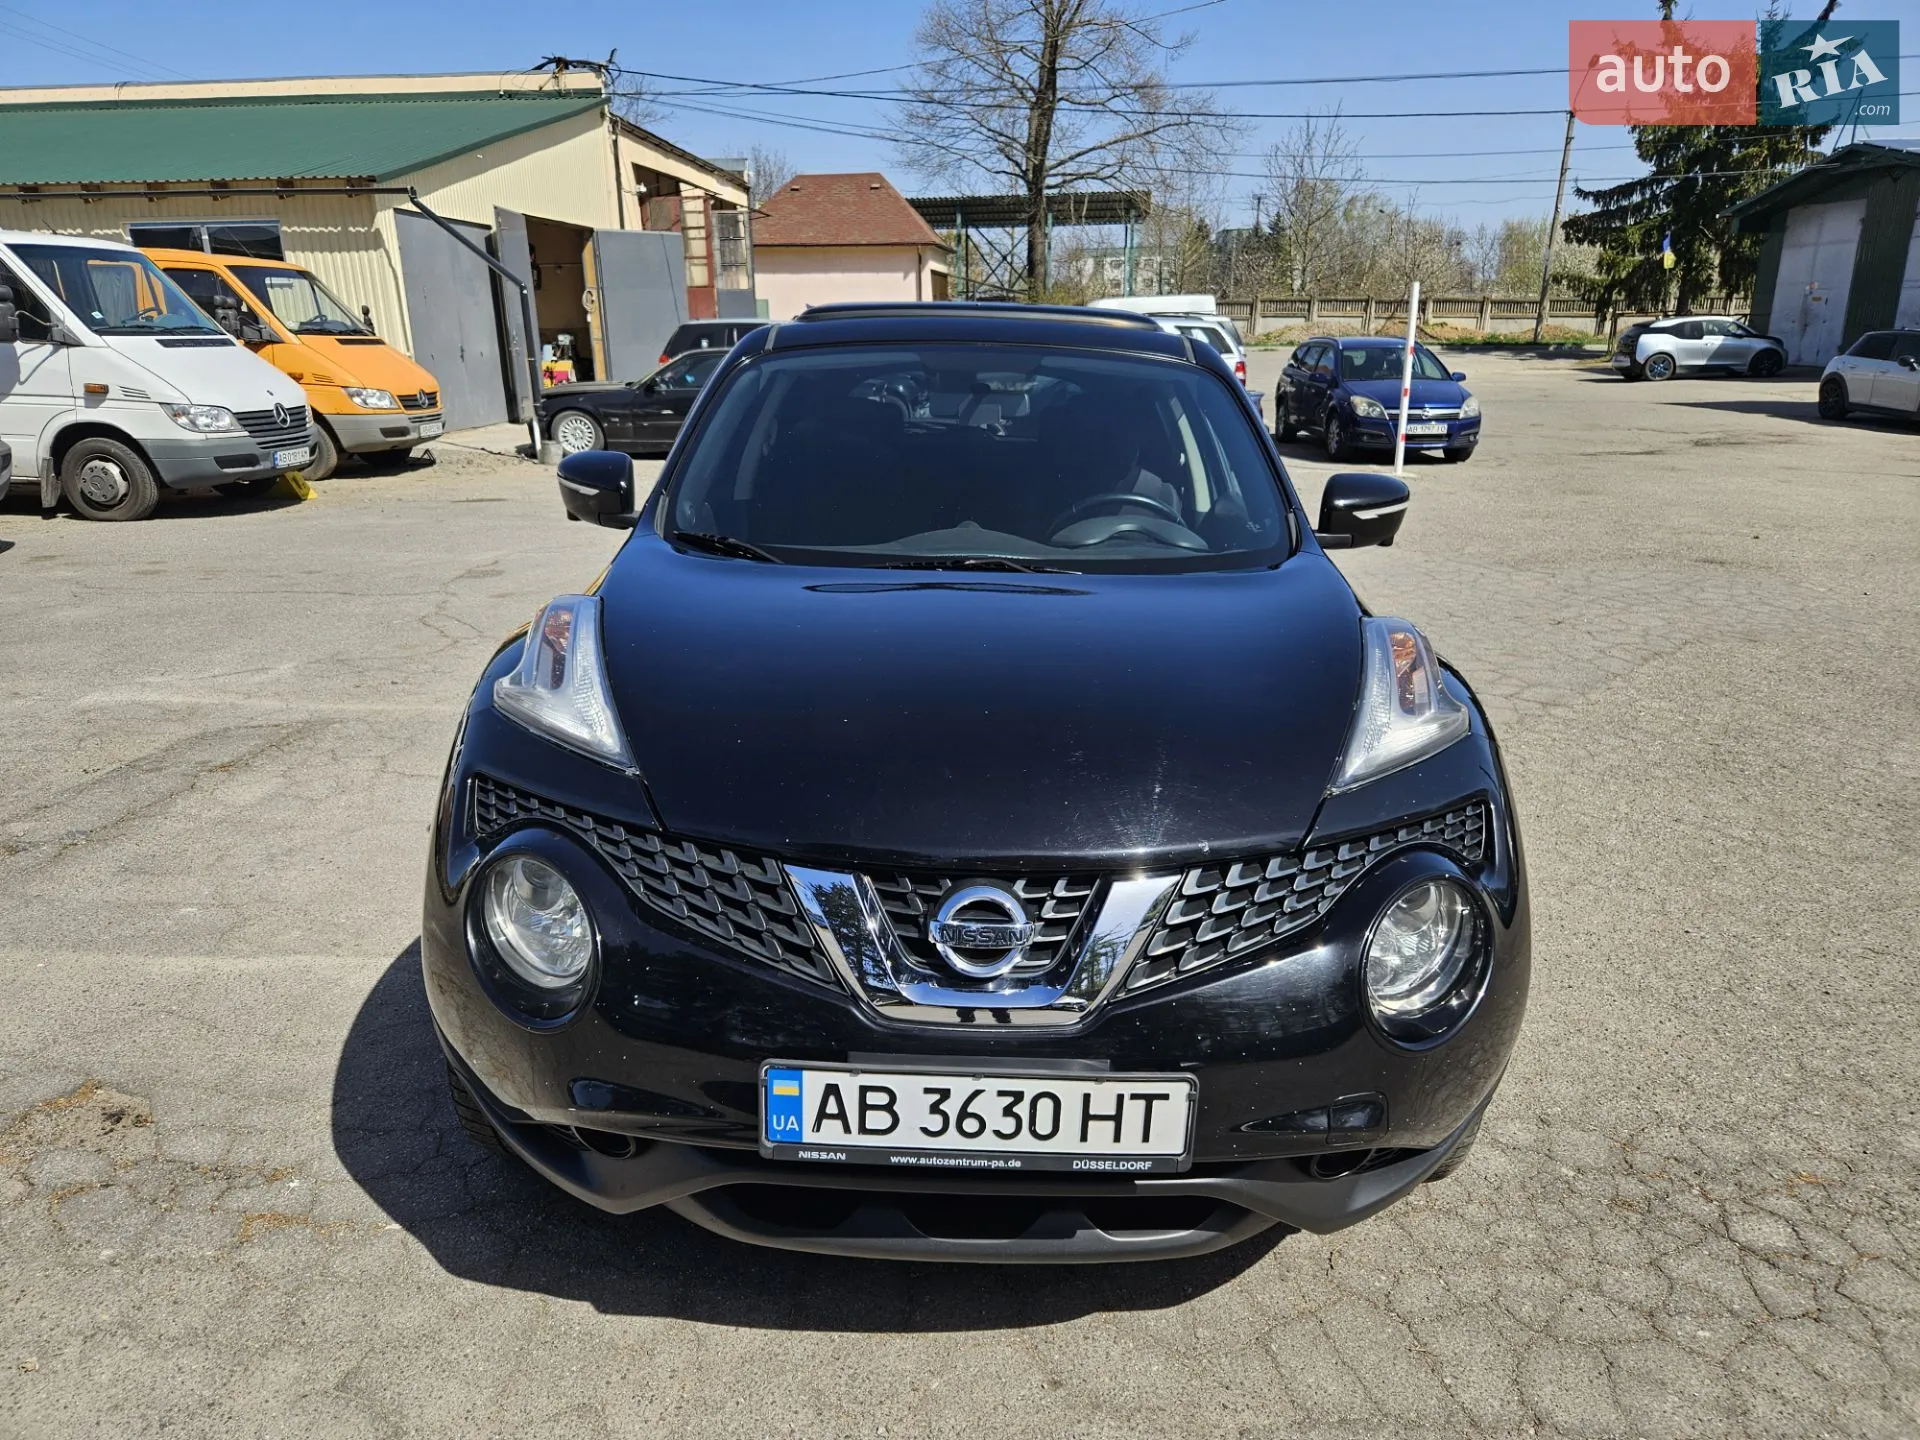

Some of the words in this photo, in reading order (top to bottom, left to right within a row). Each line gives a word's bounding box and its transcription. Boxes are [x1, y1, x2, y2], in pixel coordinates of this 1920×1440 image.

[940, 927, 1024, 943] NISSAN
[772, 1114, 800, 1132] UA
[812, 1083, 901, 1135] AB
[919, 1087, 1062, 1142] 3630
[1079, 1092, 1170, 1144] HT
[798, 1150, 847, 1160] NISSAN
[890, 1155, 1022, 1169] www.autozentrum-pa.de
[1072, 1158, 1153, 1171] DÜSSELDORF
